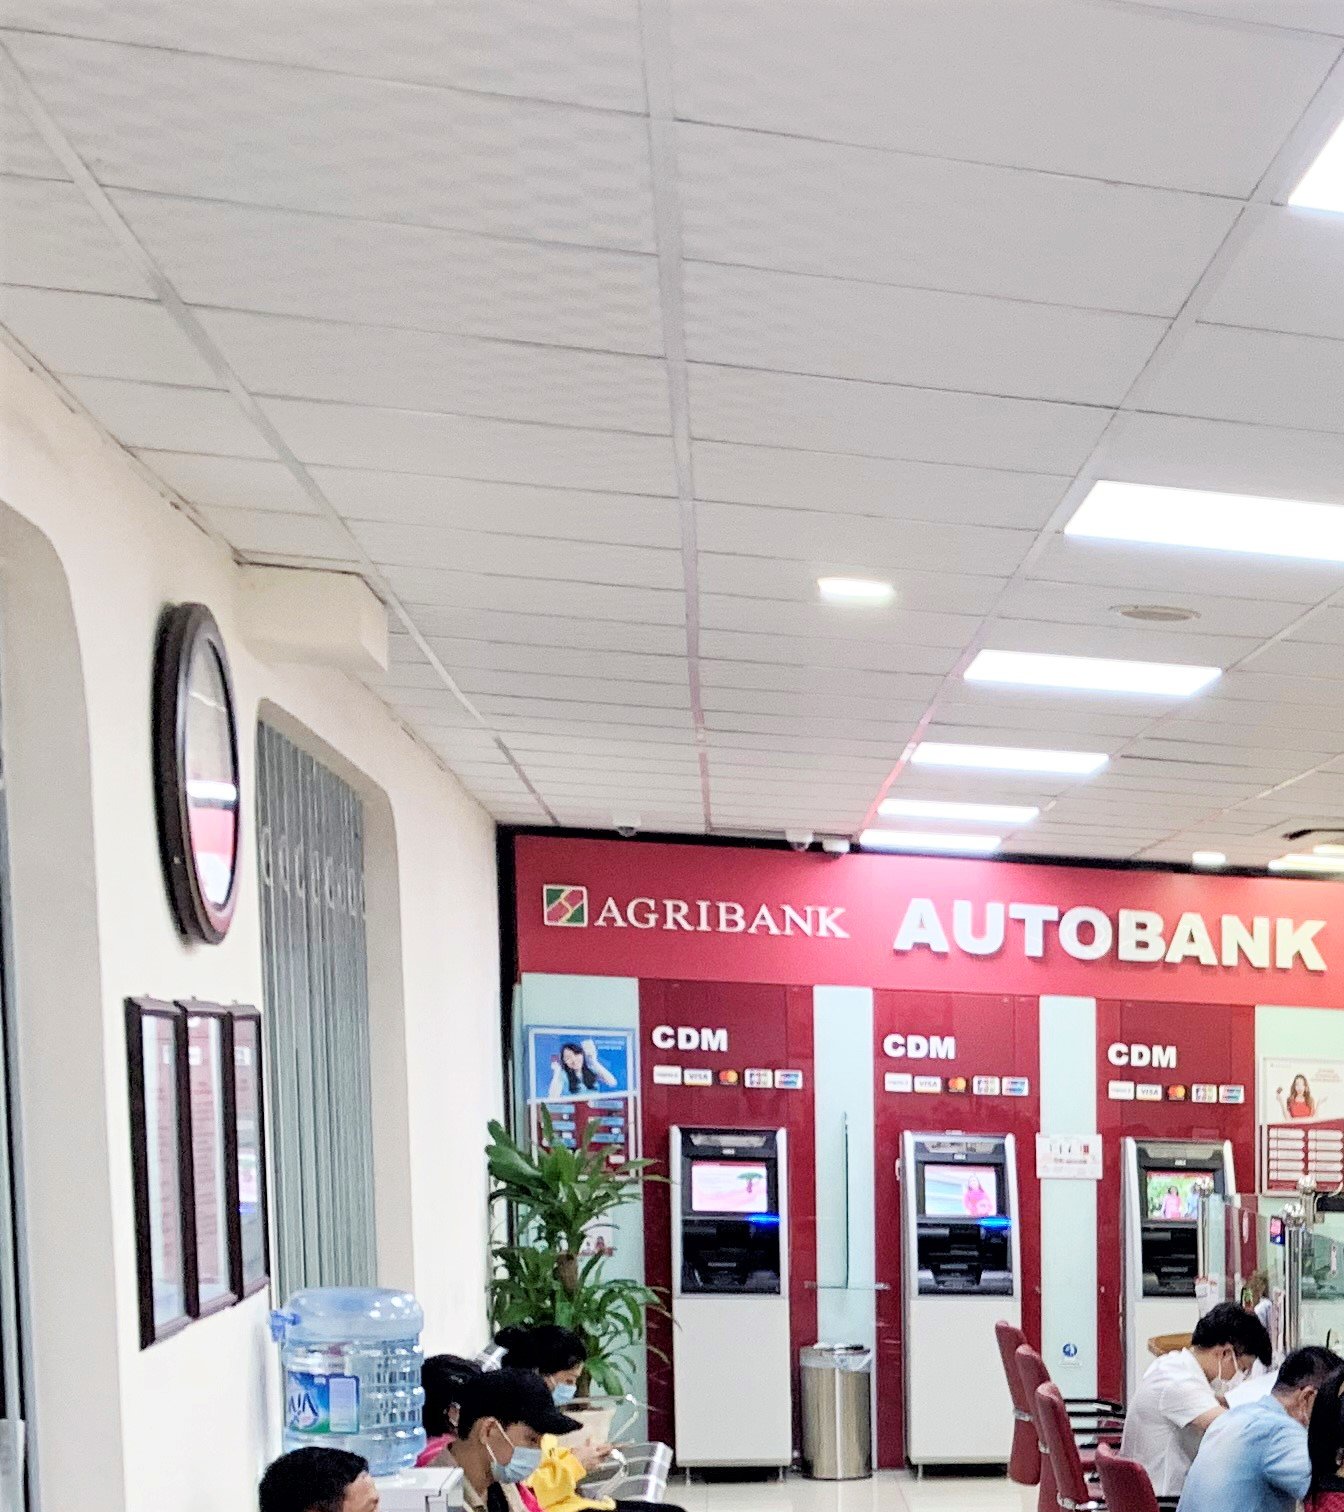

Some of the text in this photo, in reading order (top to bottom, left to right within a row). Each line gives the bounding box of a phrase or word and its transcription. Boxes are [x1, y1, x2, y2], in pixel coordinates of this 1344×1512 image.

[594, 897, 850, 939] AGRIBANK
[894, 898, 1328, 971] AUTOBANK
[652, 1025, 728, 1052] CDM
[883, 1033, 956, 1059] CDM
[1107, 1042, 1177, 1068] CDM
